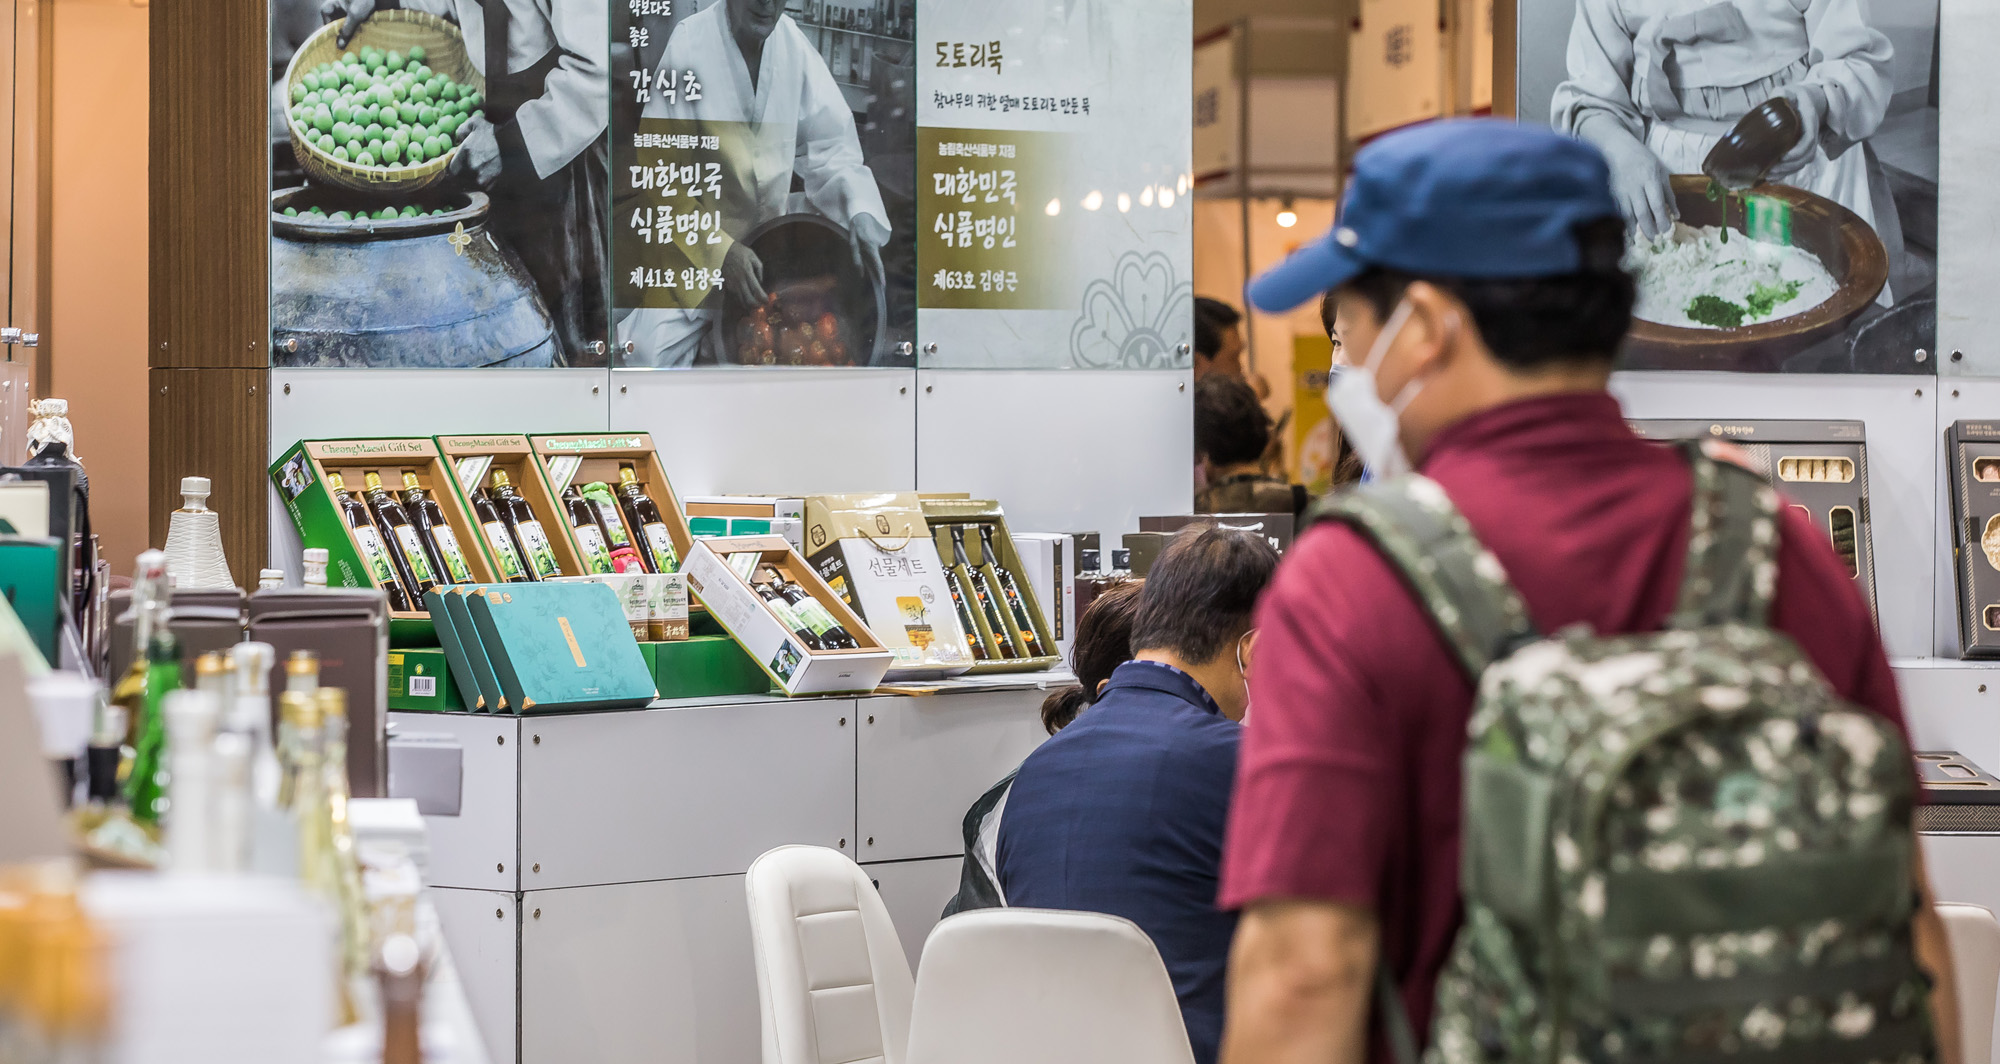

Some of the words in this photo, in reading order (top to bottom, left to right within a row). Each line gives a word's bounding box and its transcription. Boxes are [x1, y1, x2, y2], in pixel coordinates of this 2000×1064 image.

[629, 0, 671, 17] 약보다도
[629, 26, 649, 48] 좋은
[936, 40, 1003, 75] 도토리묵
[934, 90, 974, 109] 참나무의
[977, 93, 997, 111] 귀한
[1000, 95, 1020, 112] 열매
[1022, 97, 1058, 112] 도토리로
[1060, 97, 1079, 114] 만든
[1081, 97, 1091, 116] 묵
[633, 133, 699, 149] 농림축산식품부
[701, 135, 720, 150] 지정
[938, 142, 997, 157] 농림축산식품부
[998, 144, 1016, 159] 지정
[629, 159, 723, 200] 대한민국
[933, 166, 1017, 206] 대한민국
[630, 205, 723, 246] 식품명인
[934, 211, 1017, 250] 식품명인
[629, 266, 678, 290] 제41호
[681, 267, 725, 290] 임장옥
[932, 269, 976, 291] 제63호
[980, 269, 1019, 292] 김영근
[321, 443, 386, 455] CheongMaesil
[388, 442, 406, 452] Gift
[408, 442, 422, 452] Set
[448, 438, 495, 448] CheongMaesil
[496, 438, 510, 447] Gift
[510, 438, 521, 446] Set
[626, 437, 642, 448] Set
[868, 557, 927, 578] 선물세트
